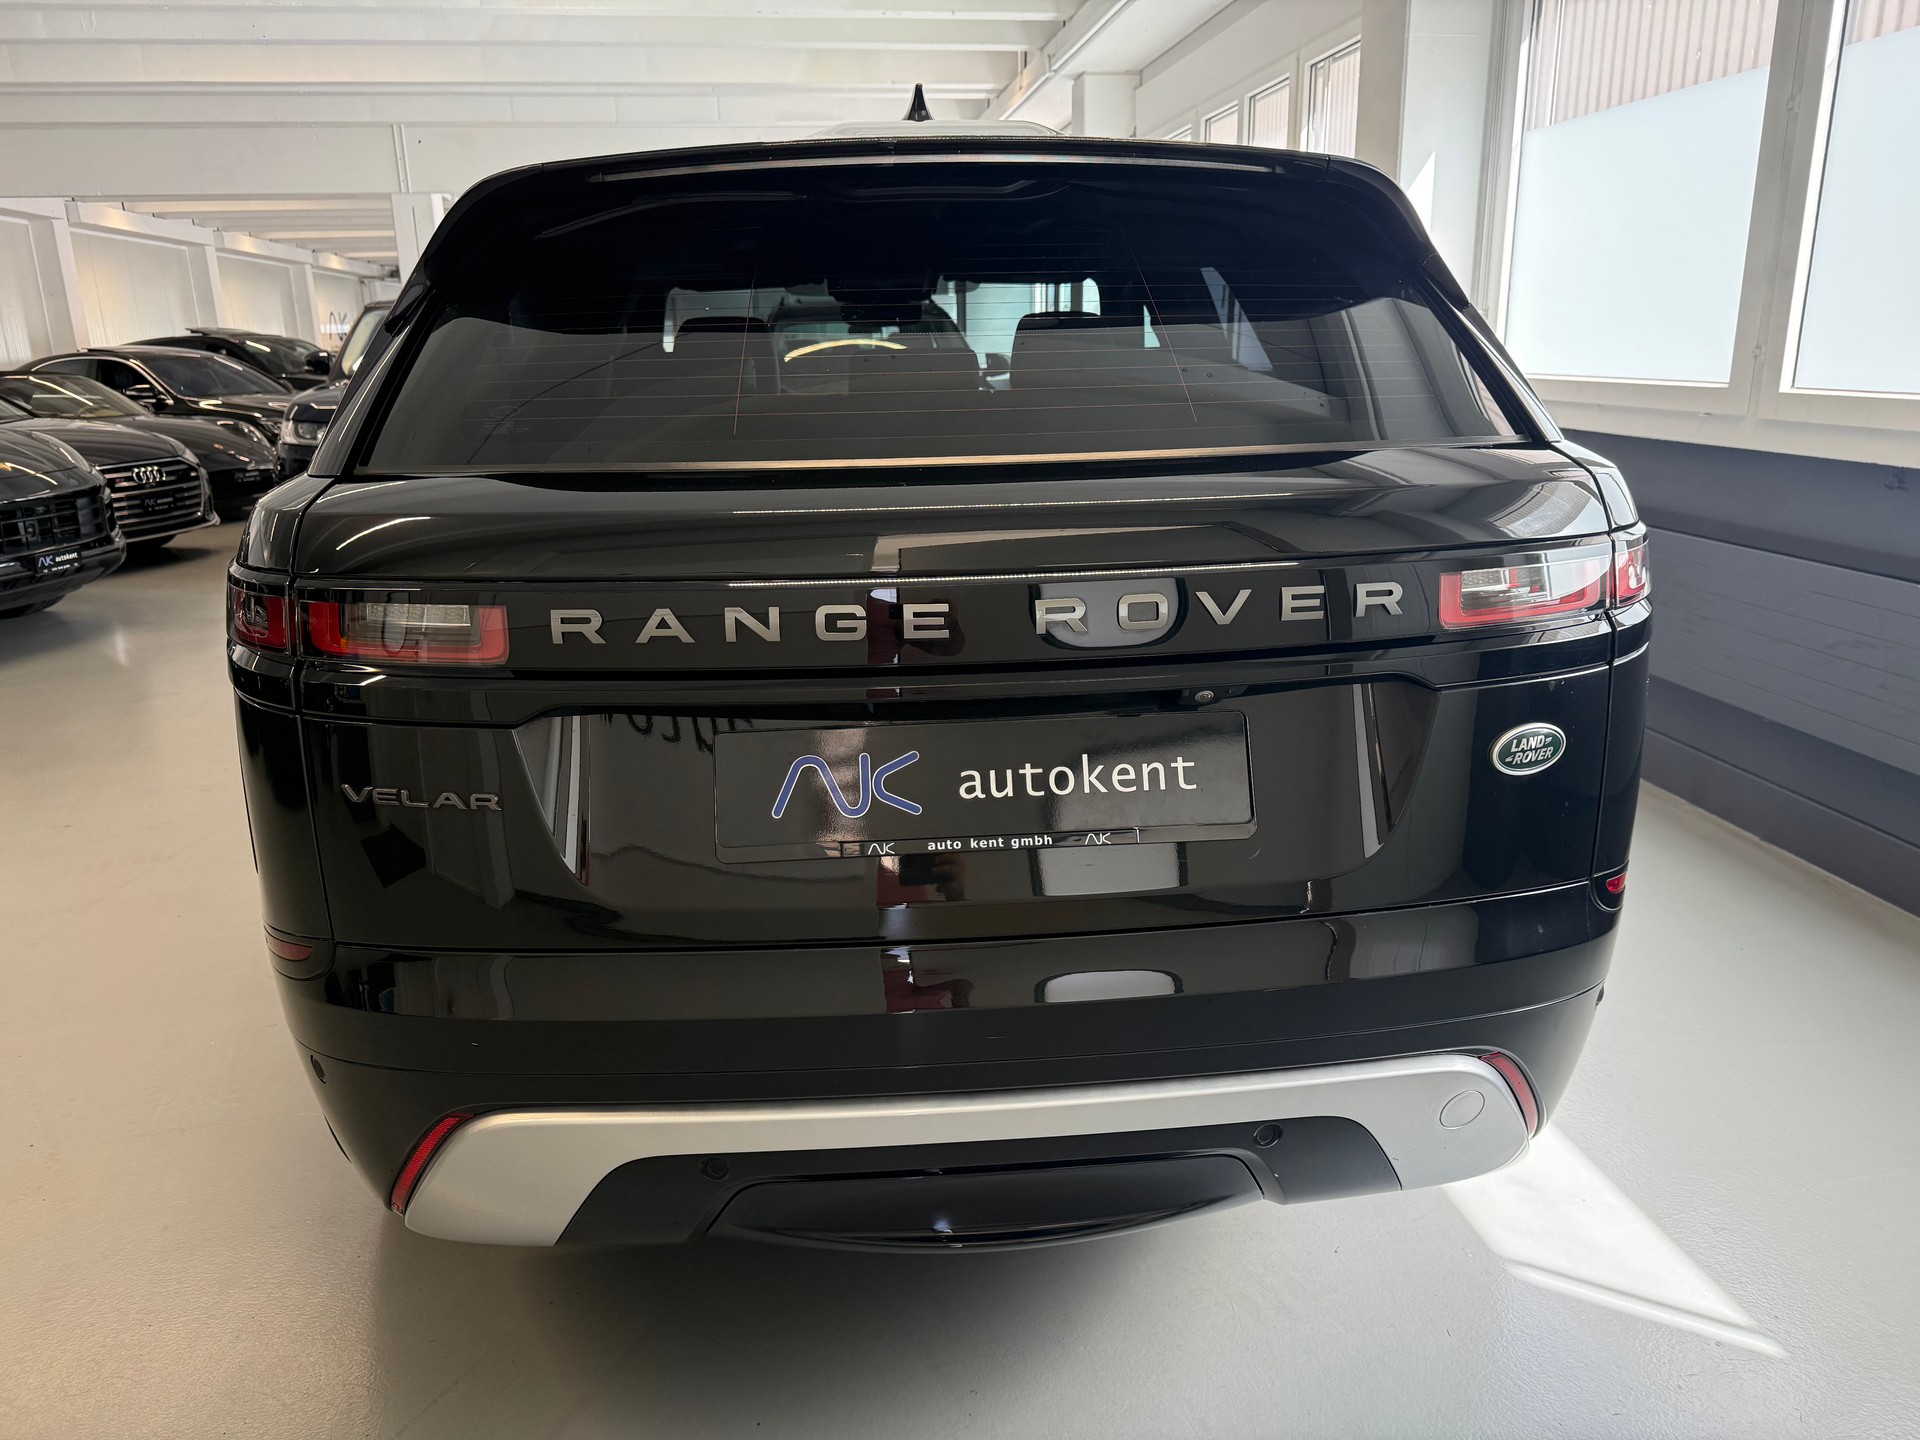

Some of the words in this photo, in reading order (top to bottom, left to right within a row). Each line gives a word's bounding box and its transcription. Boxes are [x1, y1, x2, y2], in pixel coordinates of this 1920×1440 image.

[550, 603, 950, 645] RANGE
[1034, 581, 1404, 635] ROVER
[1510, 735, 1546, 752] LAND
[1513, 746, 1554, 765] ROVER
[958, 753, 1198, 800] autokent
[340, 783, 502, 811] VELAR
[927, 839, 962, 851] auto
[970, 837, 1004, 849] kent
[1011, 835, 1053, 849] gmbh
